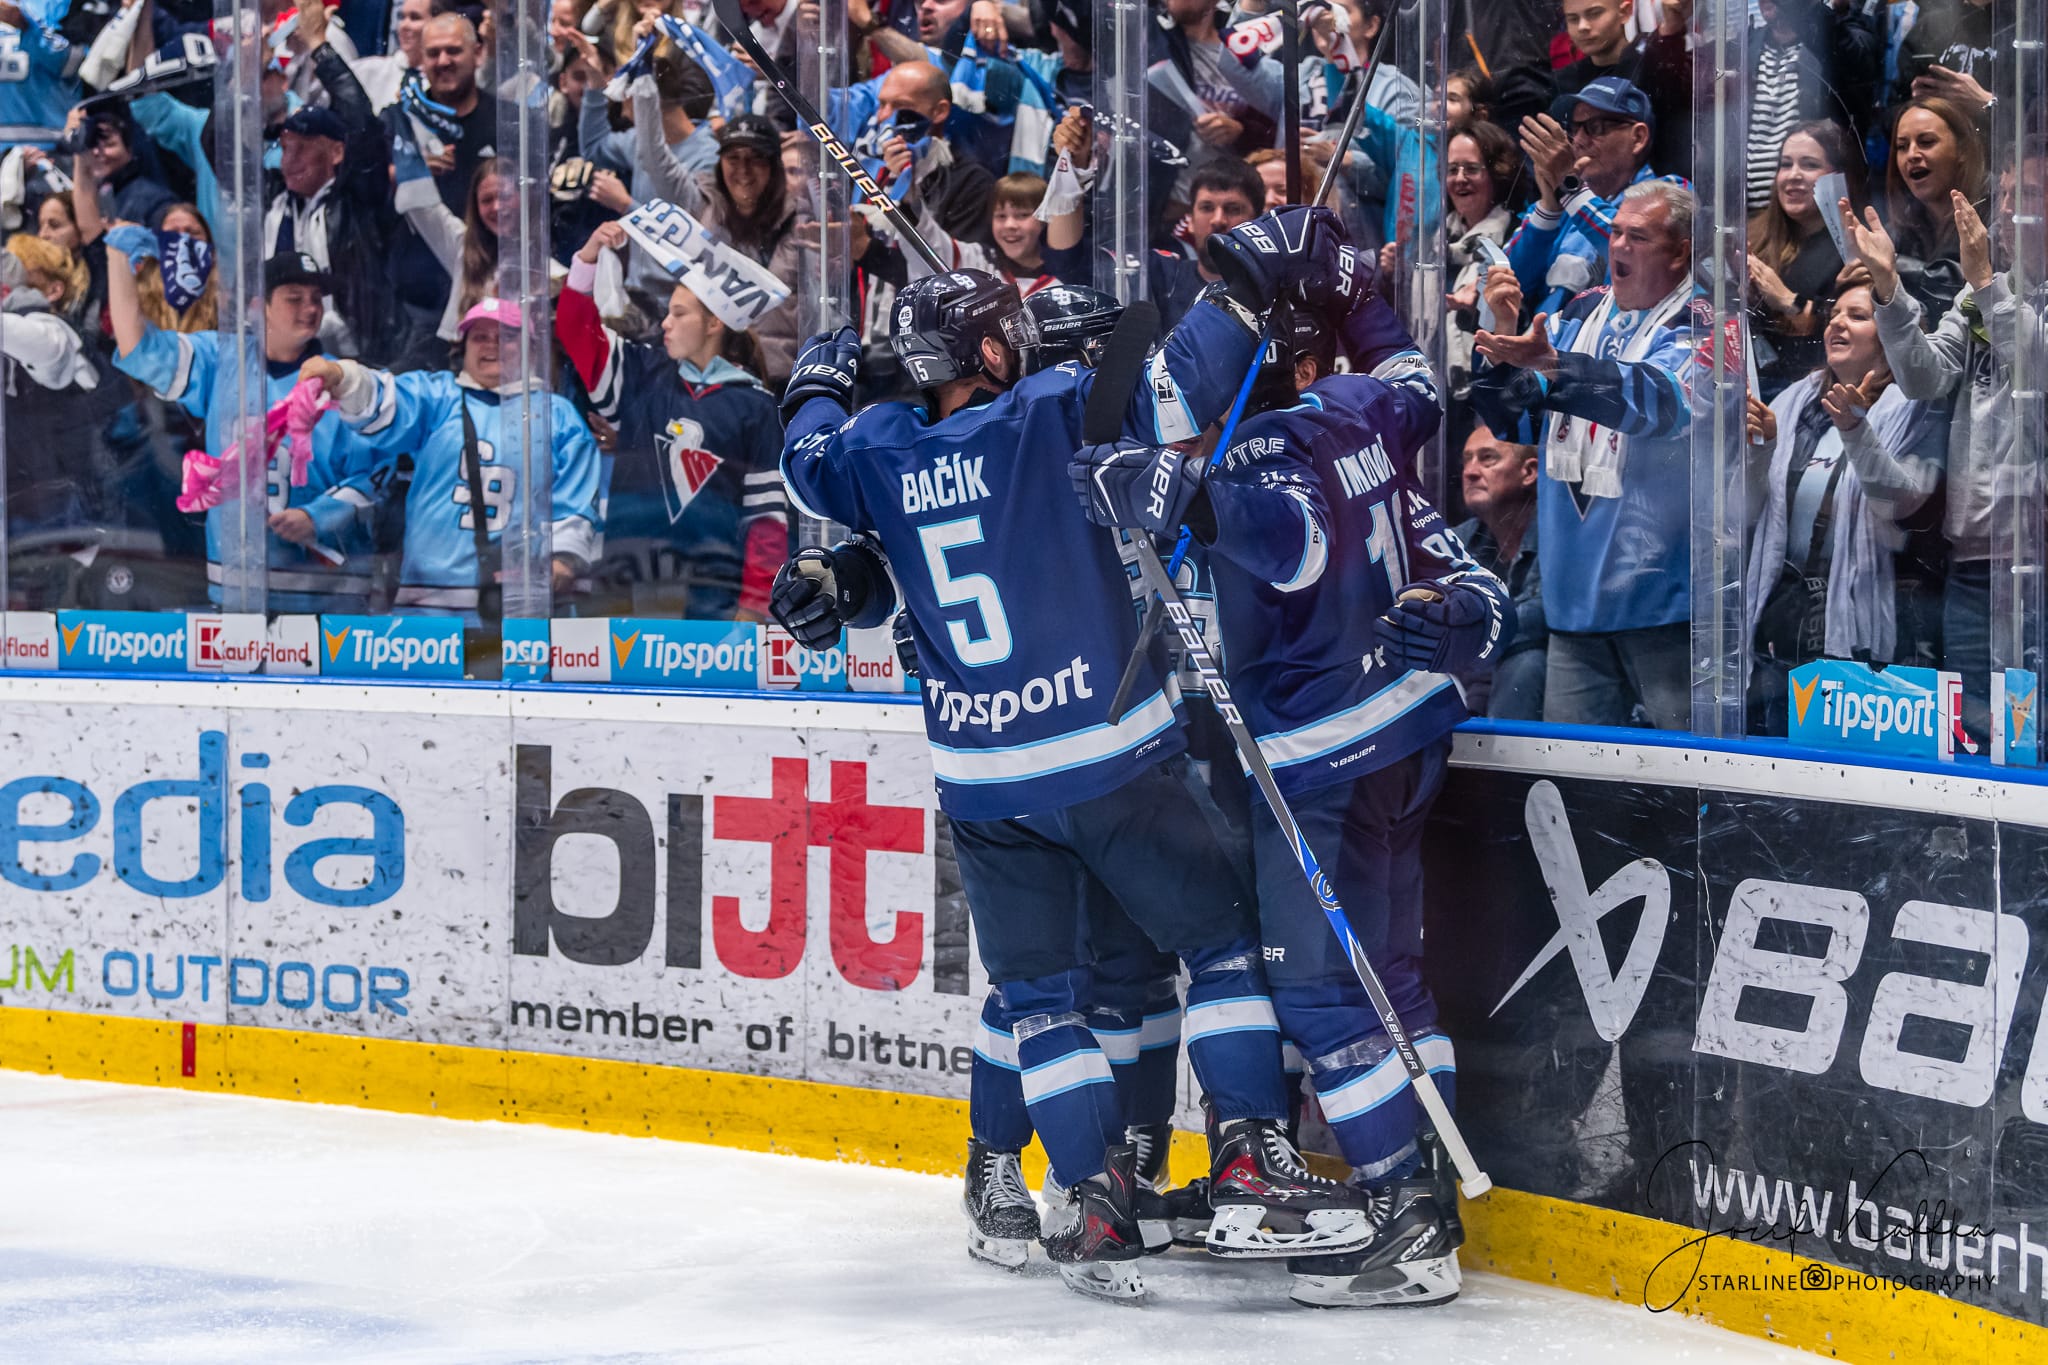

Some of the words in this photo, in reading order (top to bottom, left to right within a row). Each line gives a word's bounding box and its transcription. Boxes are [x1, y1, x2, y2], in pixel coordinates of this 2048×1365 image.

[914, 360, 930, 382] 5
[901, 452, 992, 515] BAČÍK
[916, 514, 1014, 668] 5
[86, 623, 186, 664] Tipsport
[352, 628, 461, 671] Tipsport
[642, 633, 755, 678] Tipsport
[926, 655, 1094, 733] Tipsport
[1821, 679, 1936, 742] Tipsport
[102, 950, 410, 1017] OUTDOOR
[509, 1000, 713, 1045] member
[745, 1016, 794, 1053] of
[1400, 1225, 1438, 1262] CCM
